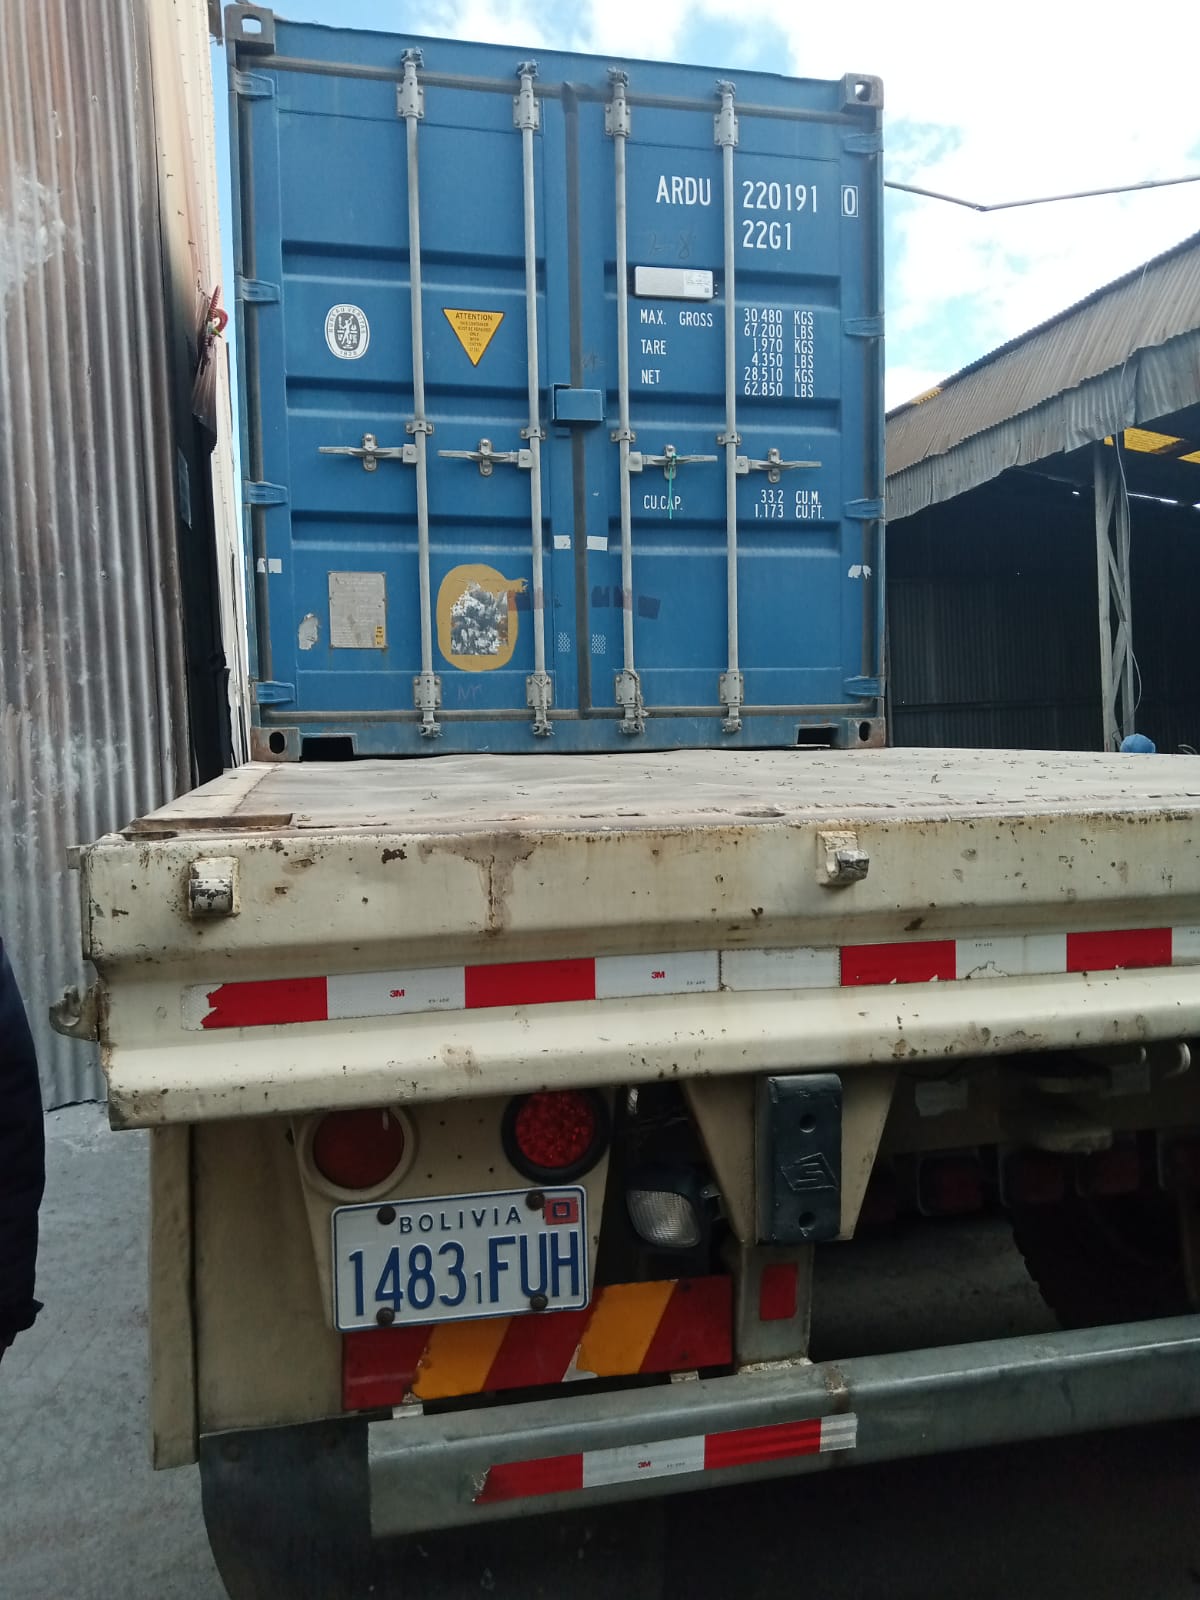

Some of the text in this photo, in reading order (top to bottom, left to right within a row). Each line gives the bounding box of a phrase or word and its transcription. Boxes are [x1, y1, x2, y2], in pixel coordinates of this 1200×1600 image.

[656, 176, 711, 206] ARDU
[742, 181, 818, 213] 220191
[742, 220, 792, 250] 22G1
[456, 312, 493, 321] ATTENTION
[640, 309, 667, 325] MAX.
[679, 311, 713, 327] GROSS
[794, 310, 814, 325] KGS
[794, 325, 814, 340] LBS
[641, 339, 667, 355] TARE
[794, 339, 814, 354] KGS
[794, 354, 814, 369] LBS
[641, 369, 661, 385] NET
[794, 368, 814, 384] KGS
[794, 383, 814, 398] LBS
[760, 489, 784, 504] 33.2
[651, 971, 666, 979] 3M
[389, 989, 405, 998] 3M
[399, 1206, 522, 1234] BOLIVIA
[637, 1460, 651, 1469] 3M
